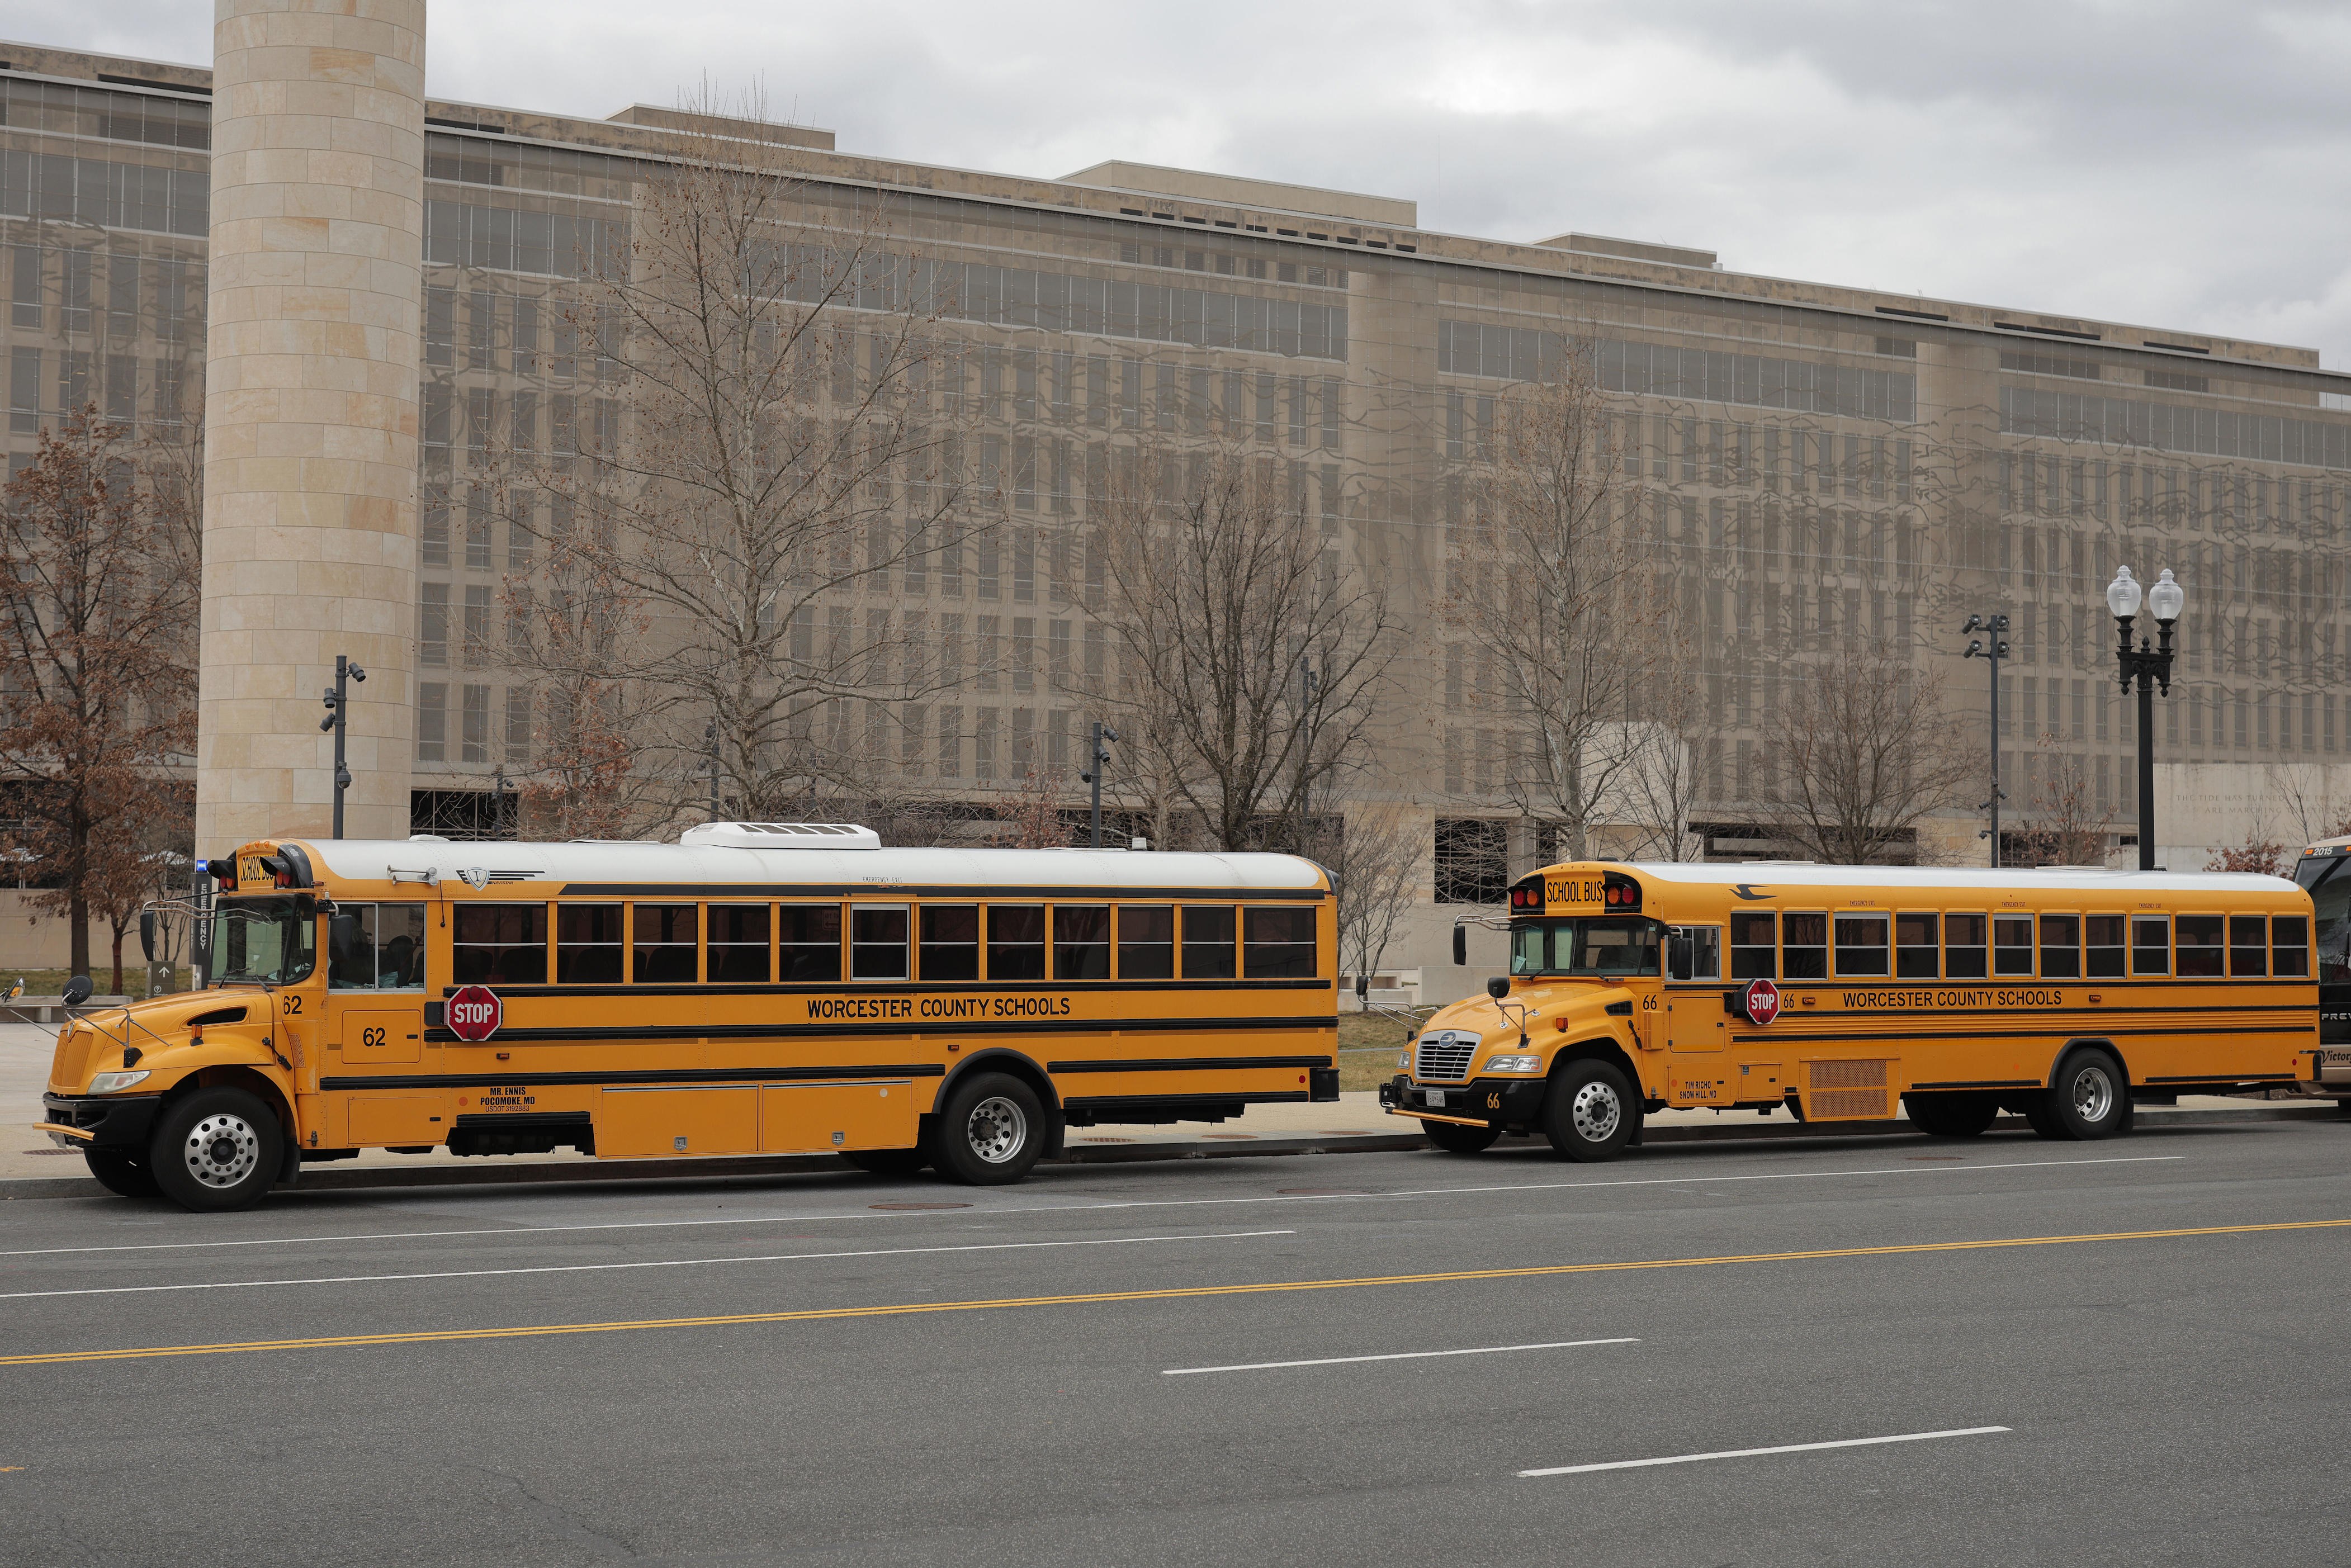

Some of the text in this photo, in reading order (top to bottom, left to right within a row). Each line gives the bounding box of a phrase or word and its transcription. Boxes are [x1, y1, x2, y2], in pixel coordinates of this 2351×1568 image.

[2313, 847, 2333, 856] 2015
[241, 855, 261, 882] SCHOOL
[1547, 880, 1602, 902] SCHOOL BUS
[283, 995, 302, 1015] 62
[1643, 994, 1657, 1010] 66
[1751, 993, 1775, 1010] STOP
[1784, 993, 1794, 1008] 66
[1843, 991, 2062, 1007] WORCESTER COUNTY SCHOOLS
[455, 1003, 494, 1024] STOP
[807, 997, 1070, 1018] WORCESTER COUNTY SCHOOLS
[363, 1027, 386, 1047] 62
[490, 1087, 526, 1096] MR. ENNIS
[1685, 1081, 1711, 1089] TIM RICHO
[480, 1096, 535, 1106] POCOMOKE, MD
[1487, 1092, 1499, 1109] 66
[1680, 1090, 1716, 1100] SNOW HILL, MD
